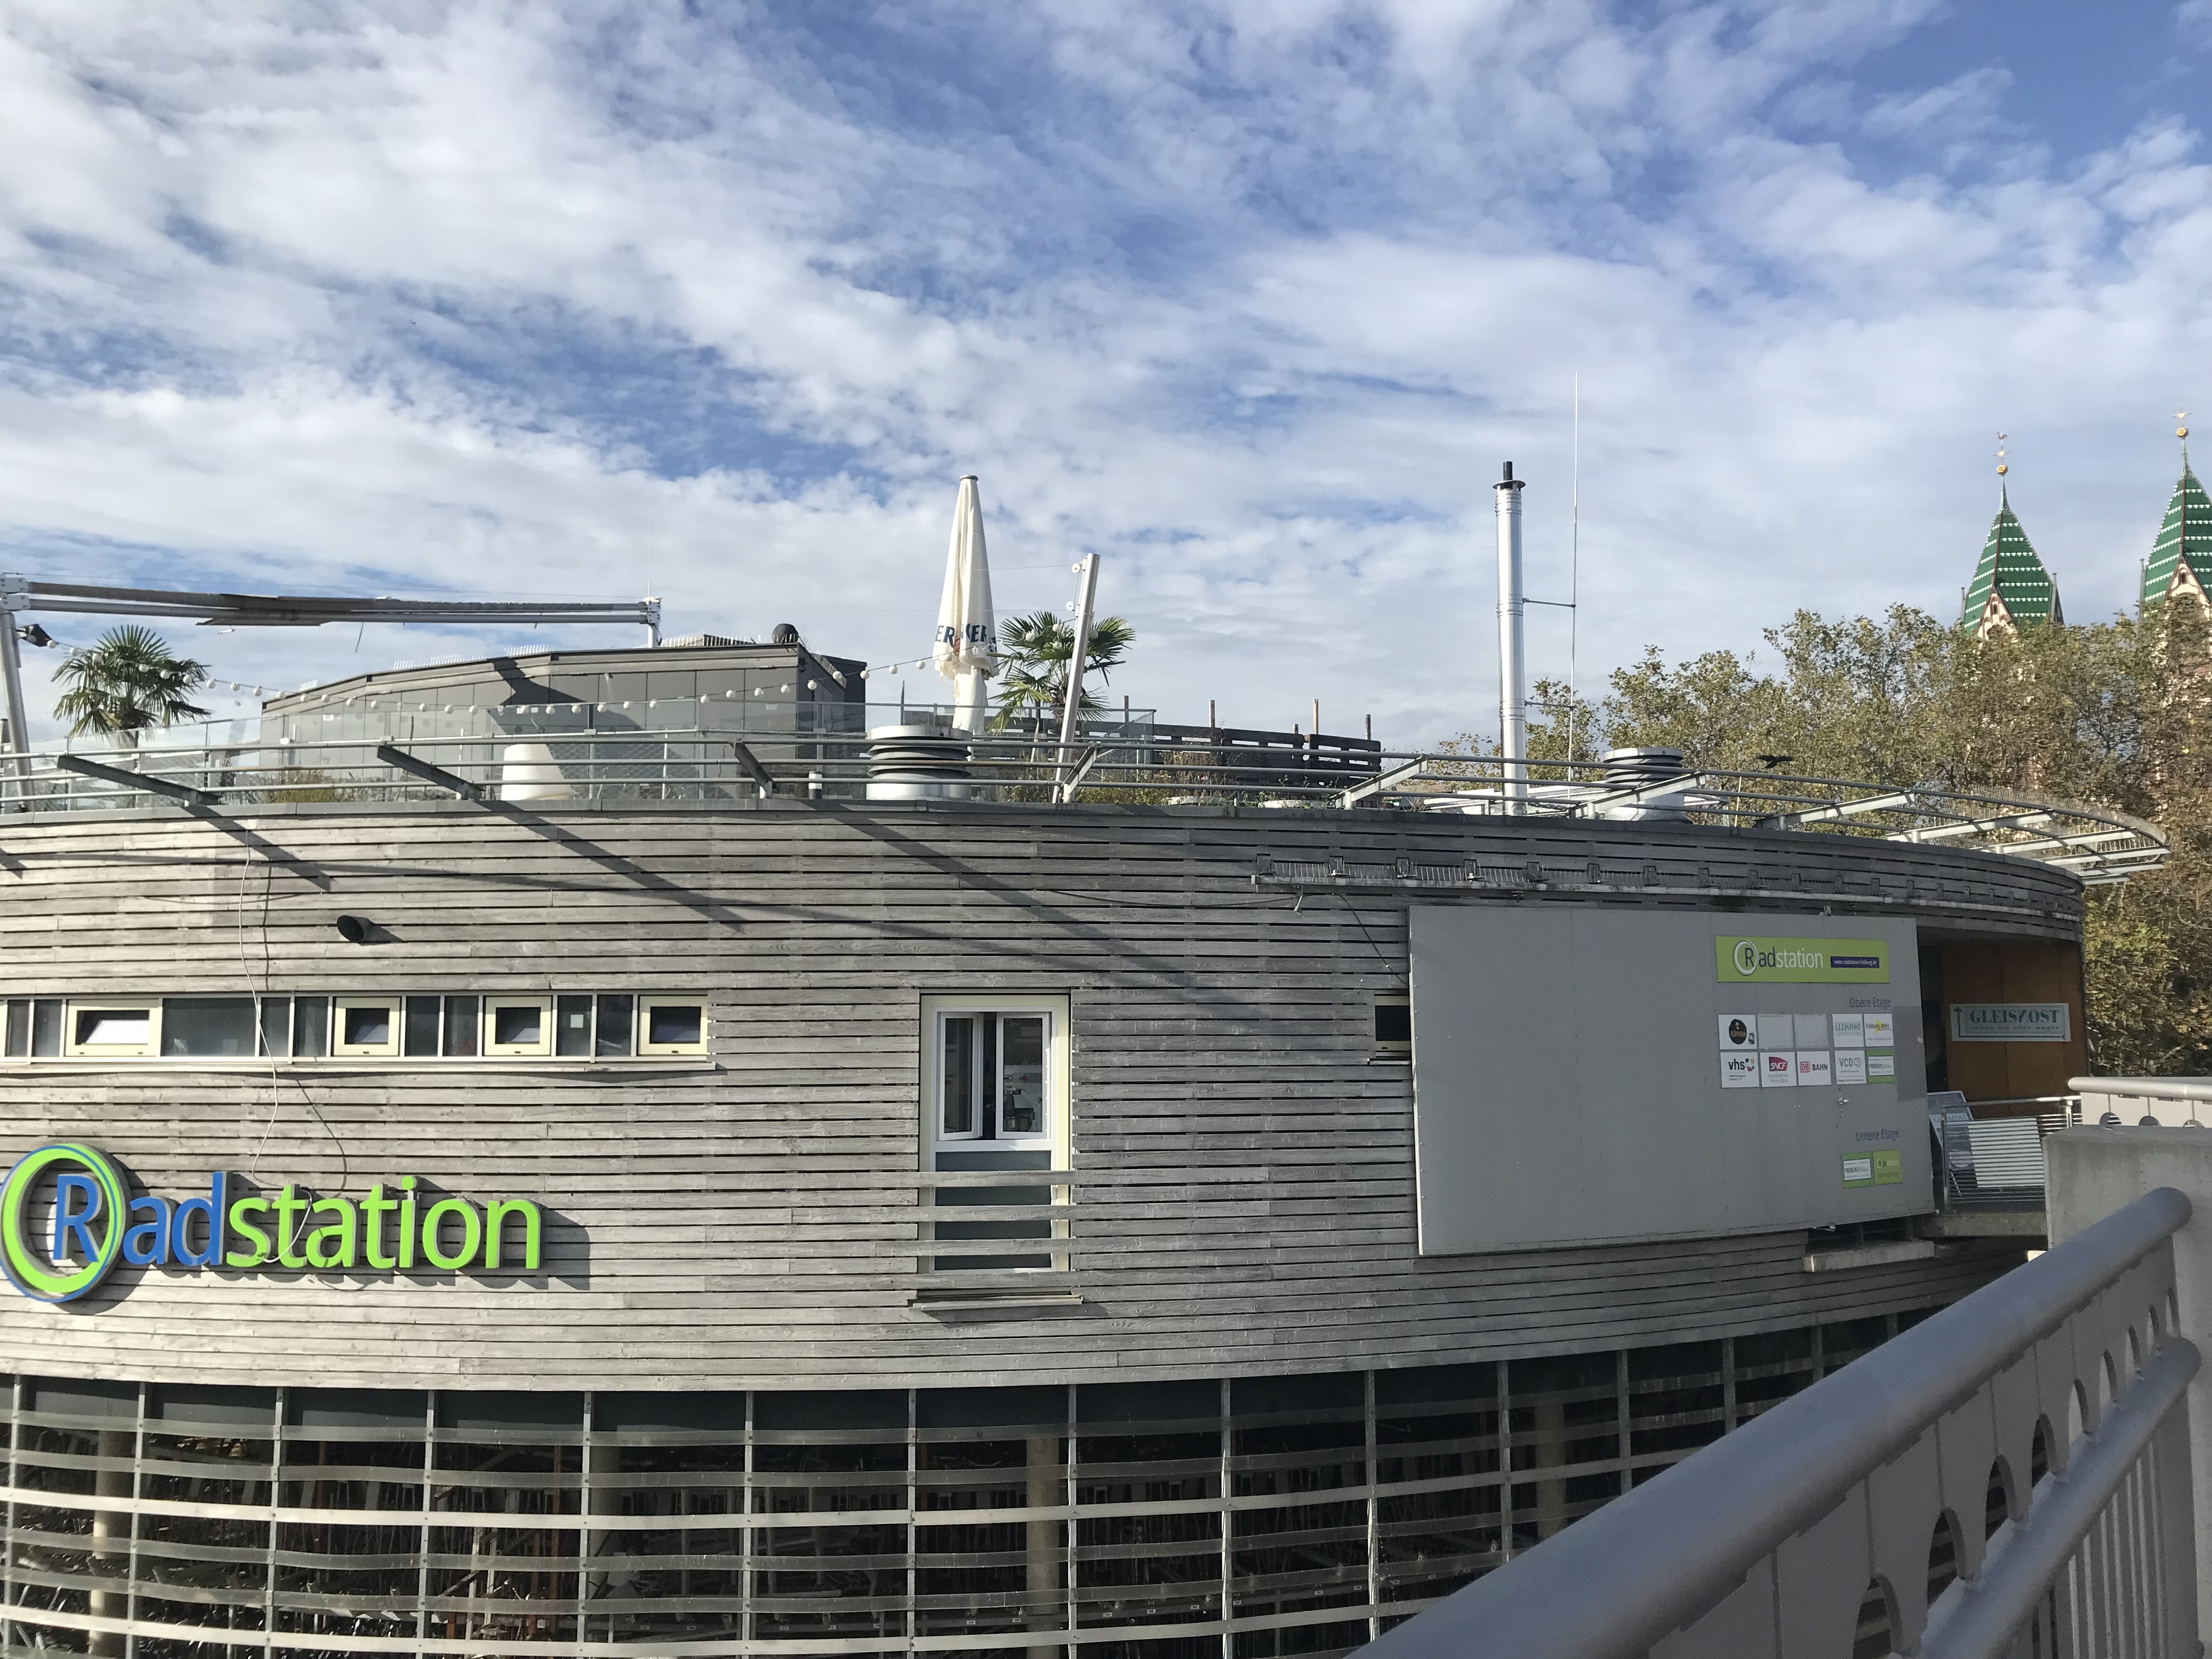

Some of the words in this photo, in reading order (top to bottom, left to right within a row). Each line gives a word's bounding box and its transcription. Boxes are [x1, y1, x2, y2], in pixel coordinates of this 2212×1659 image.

[1745, 946, 1824, 968] Radstation
[1849, 997, 1871, 1007] Obere
[1873, 997, 1891, 1009] Etage
[1728, 1058, 1745, 1070] vhs
[1839, 1058, 1853, 1068] VCD
[1855, 1132, 1880, 1142] Untere
[1881, 1128, 1899, 1142] Etage
[53, 1171, 545, 1271] Radstation
